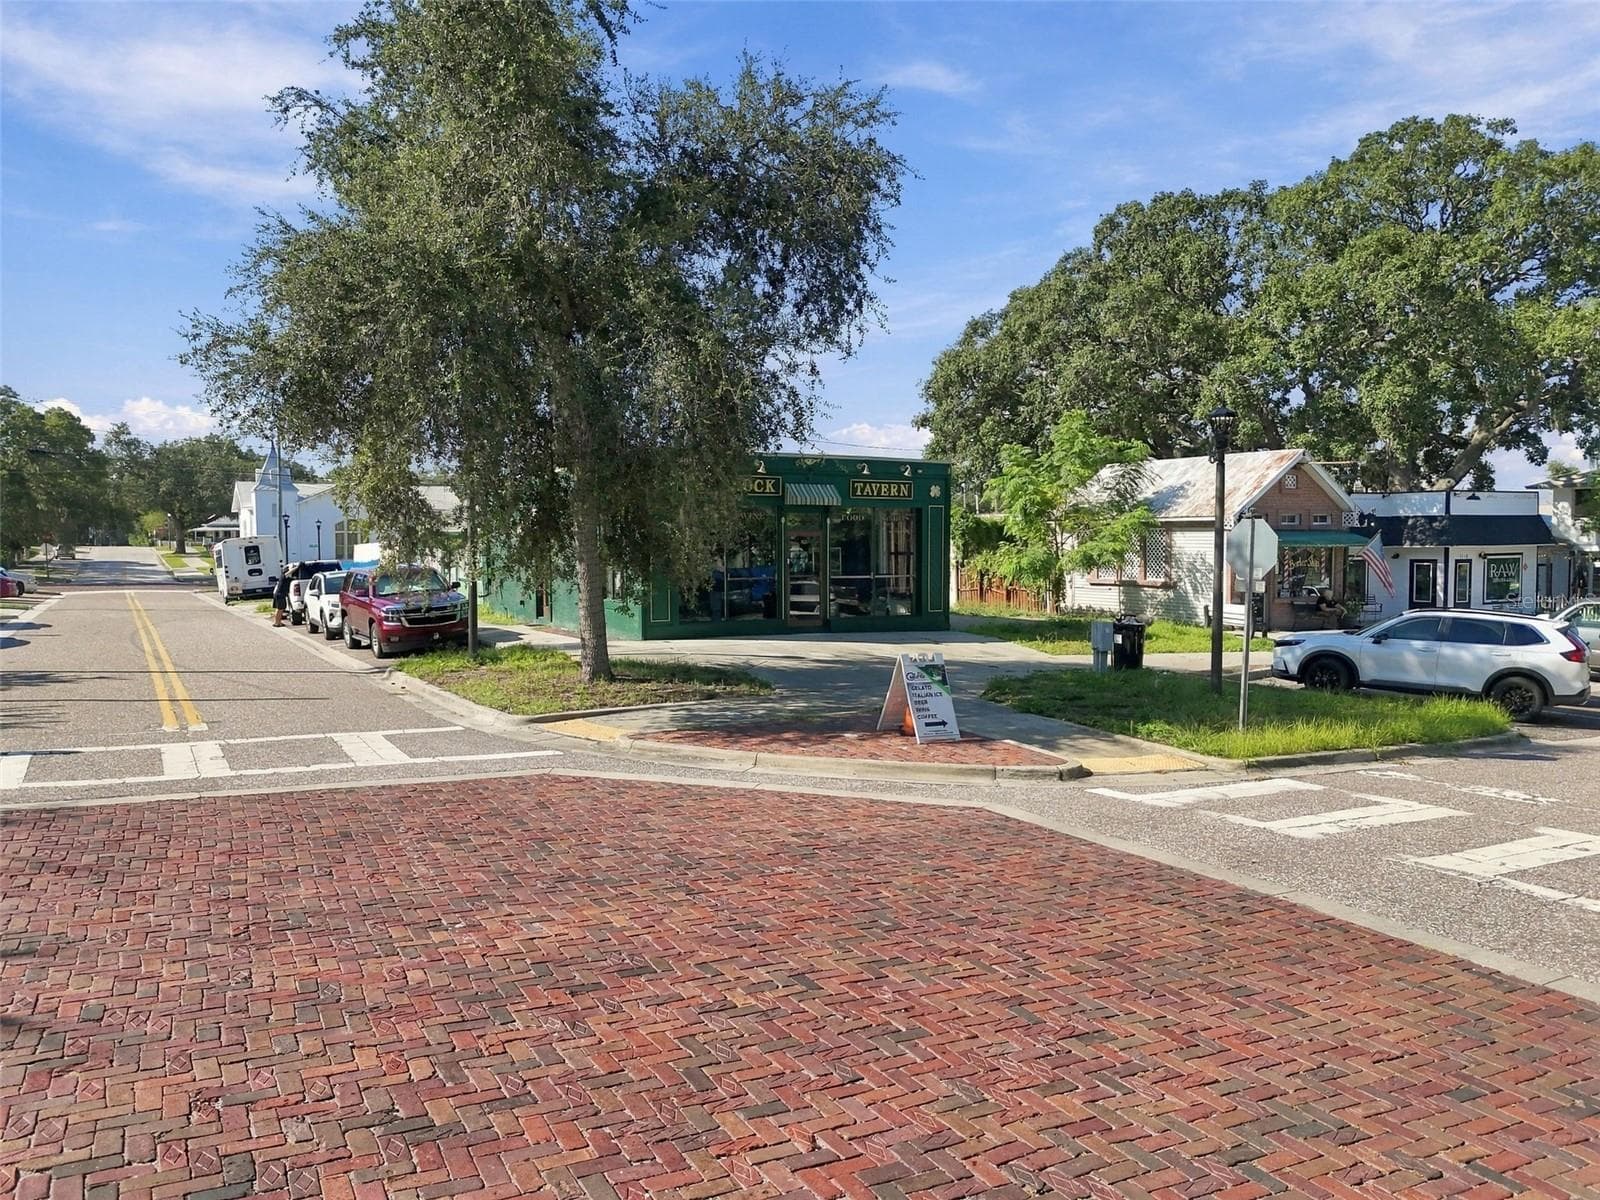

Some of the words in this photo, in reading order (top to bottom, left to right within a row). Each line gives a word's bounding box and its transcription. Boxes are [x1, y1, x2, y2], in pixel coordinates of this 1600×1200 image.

[742, 478, 777, 493] OCK
[854, 482, 910, 497] TAVERN
[841, 513, 865, 521] FOOD
[1490, 562, 1519, 577] RAW
